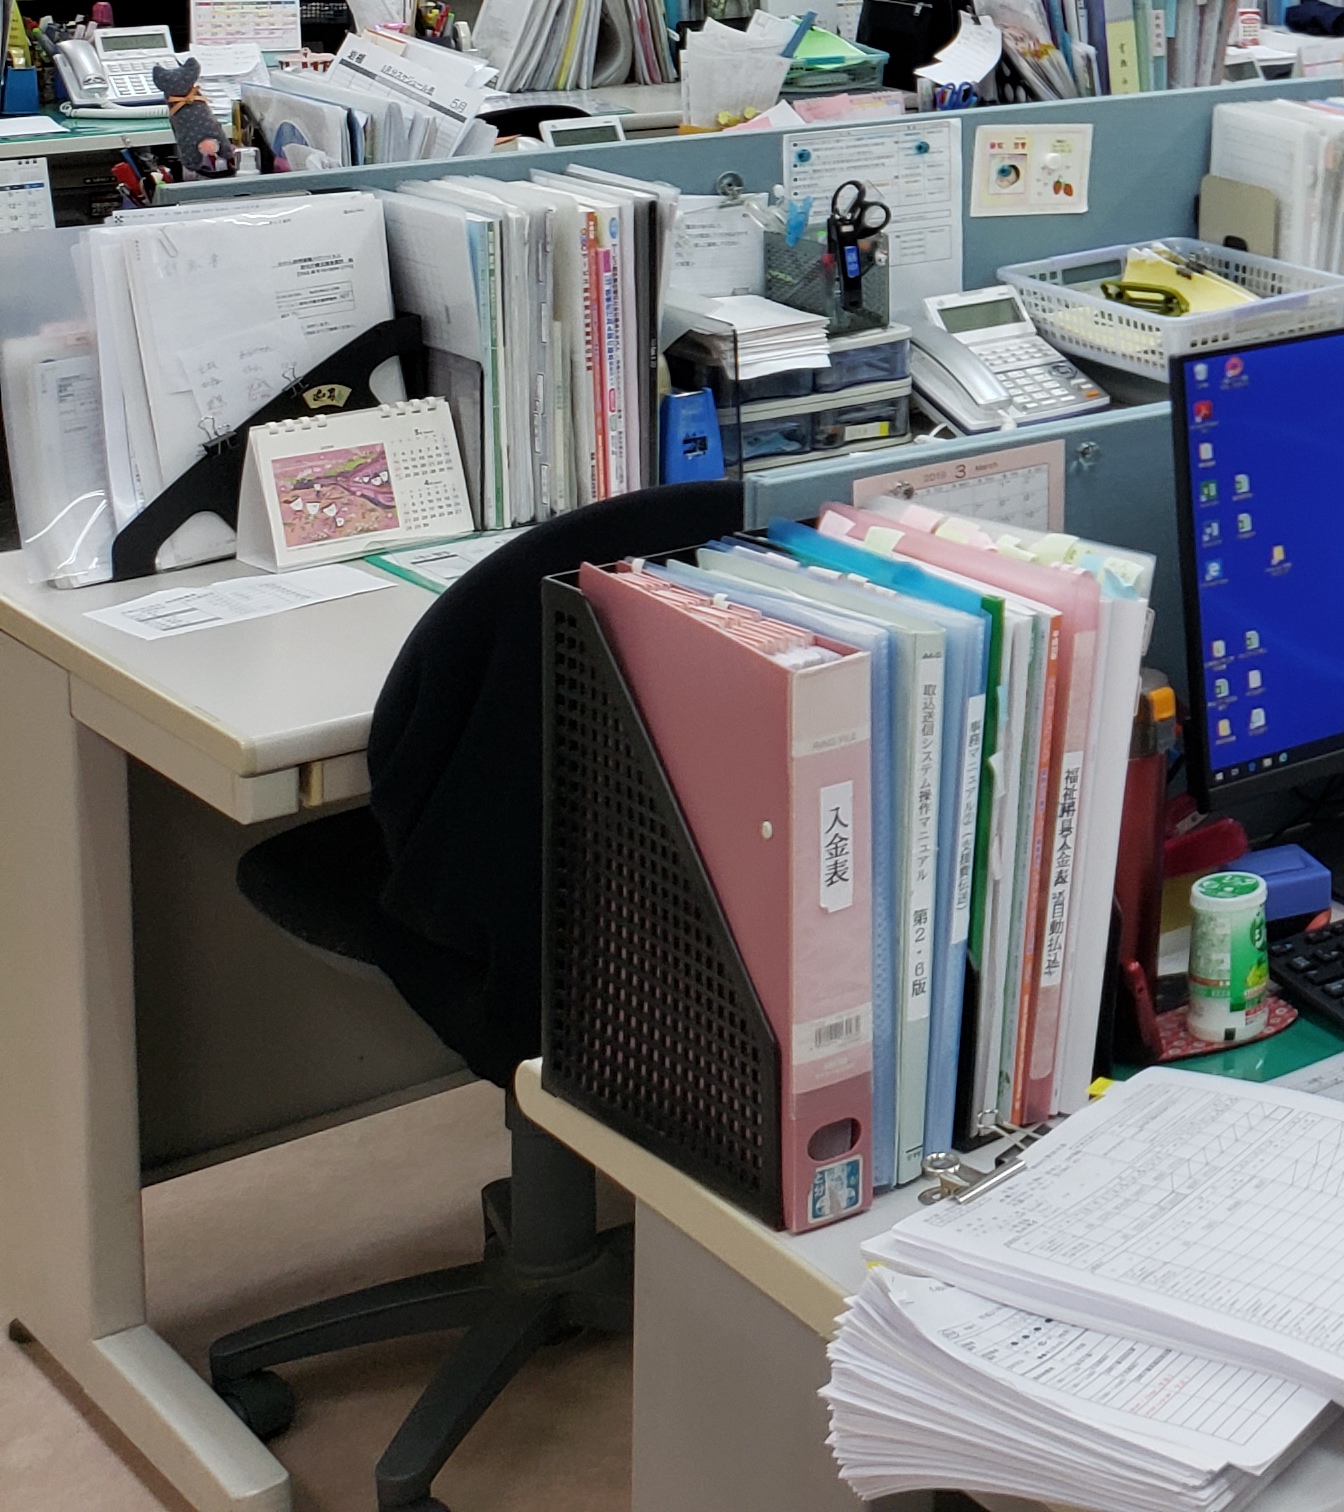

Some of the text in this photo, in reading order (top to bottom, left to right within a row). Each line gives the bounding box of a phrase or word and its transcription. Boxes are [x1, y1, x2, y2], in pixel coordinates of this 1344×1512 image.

[450, 98, 468, 113] 5月
[924, 461, 998, 482] 2019 3 March
[917, 683, 938, 882] 取込送信システム操作マニュアル
[824, 805, 850, 888] 入金表
